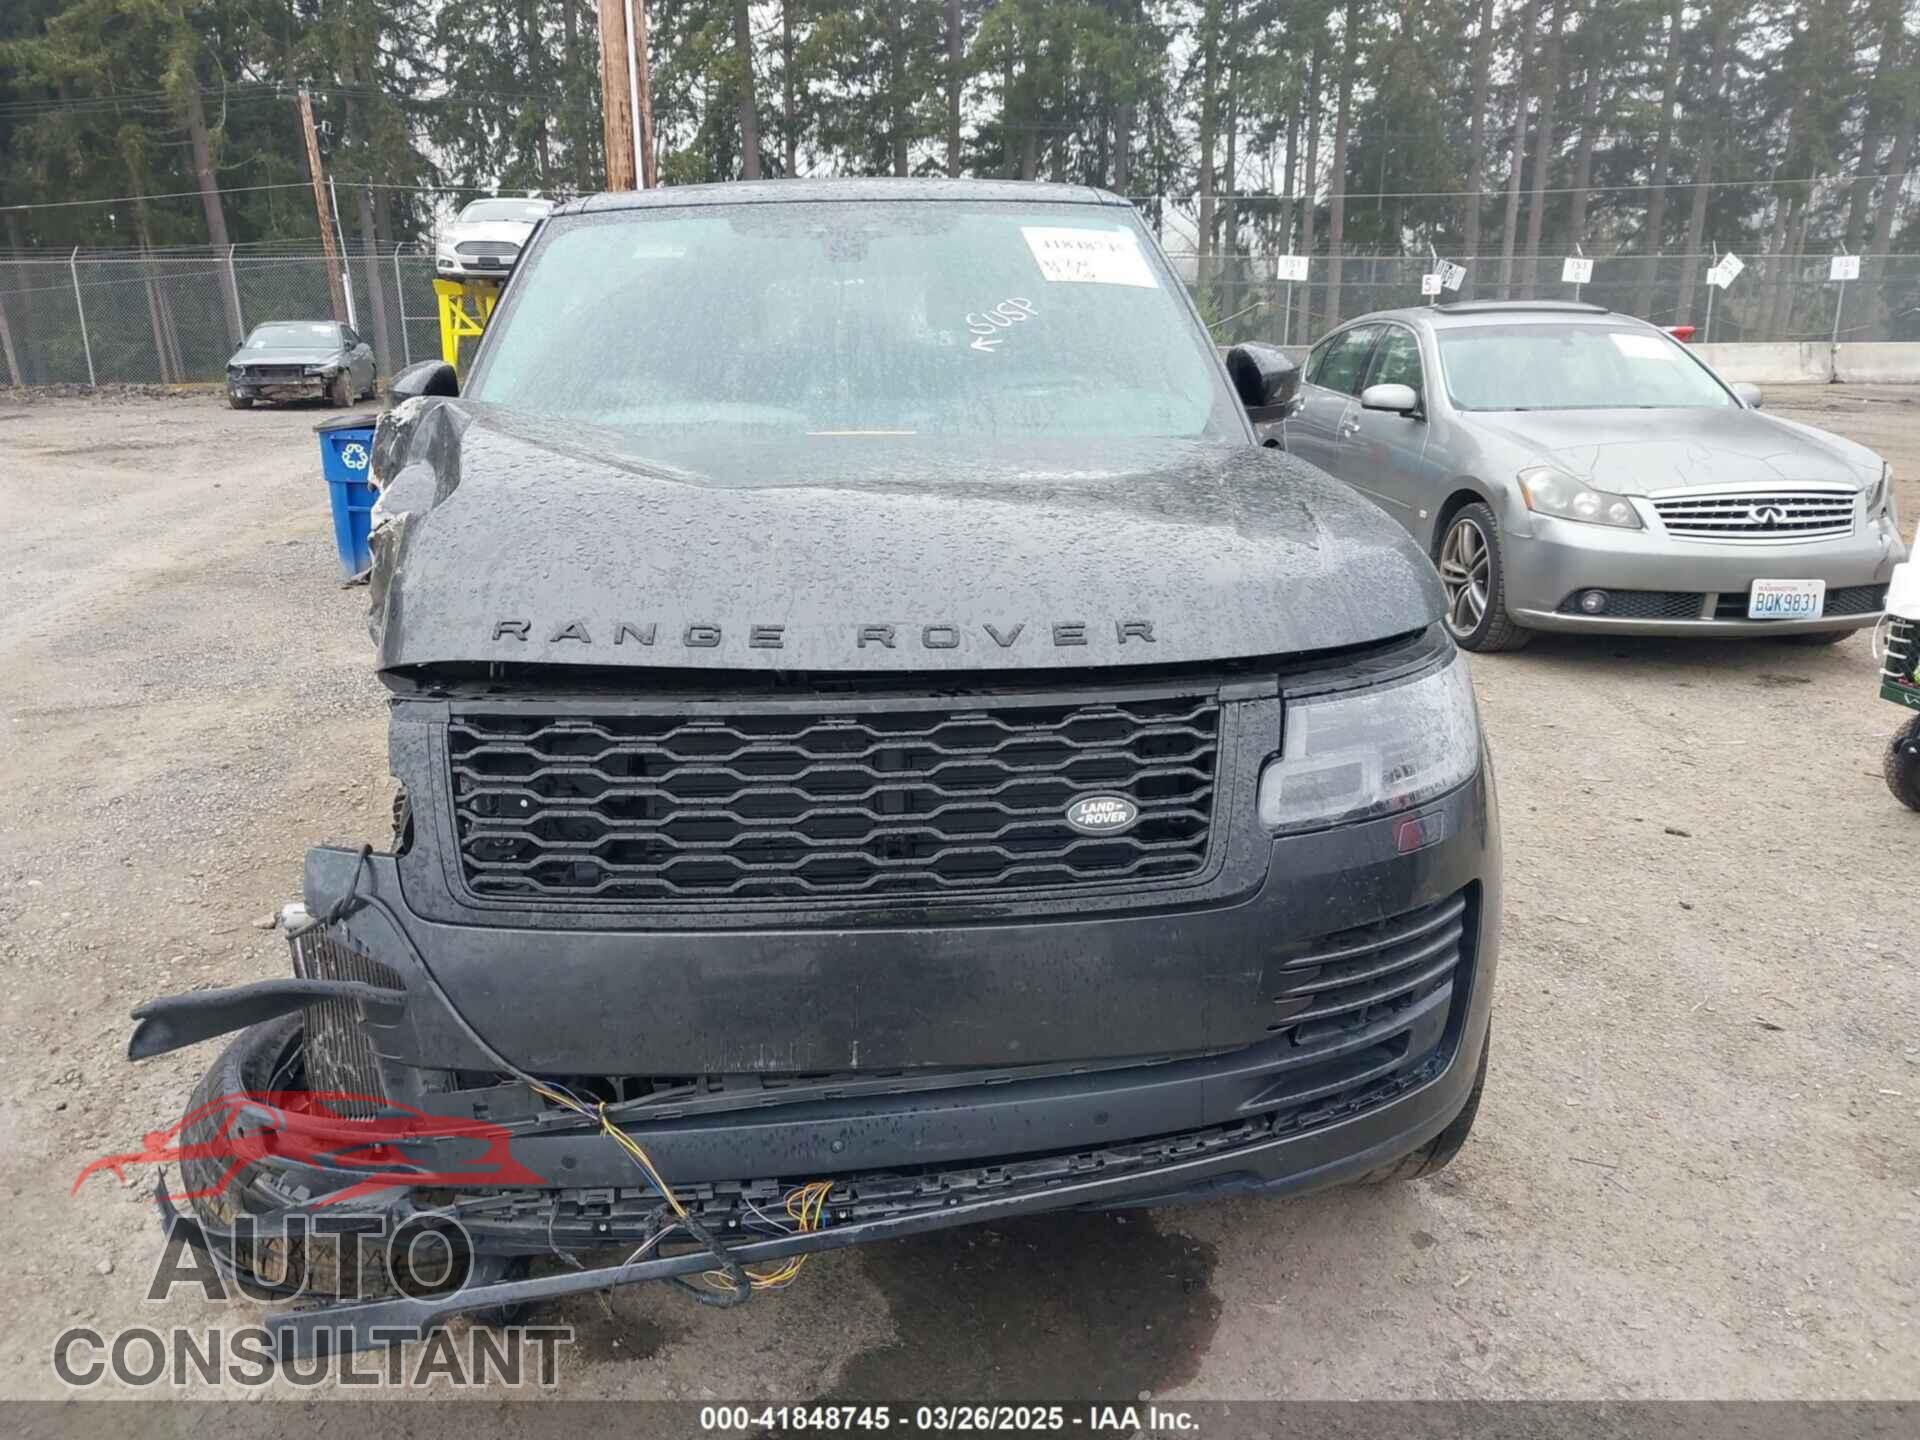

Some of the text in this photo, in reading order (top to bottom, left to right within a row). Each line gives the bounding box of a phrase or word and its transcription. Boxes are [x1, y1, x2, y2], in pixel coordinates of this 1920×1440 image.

[965, 296, 1039, 335] SUSP
[1755, 592, 1817, 611] BQK9831
[492, 620, 1157, 649] RANGE ROVER
[1081, 802, 1115, 814] LAND
[1085, 811, 1127, 824] ROVER
